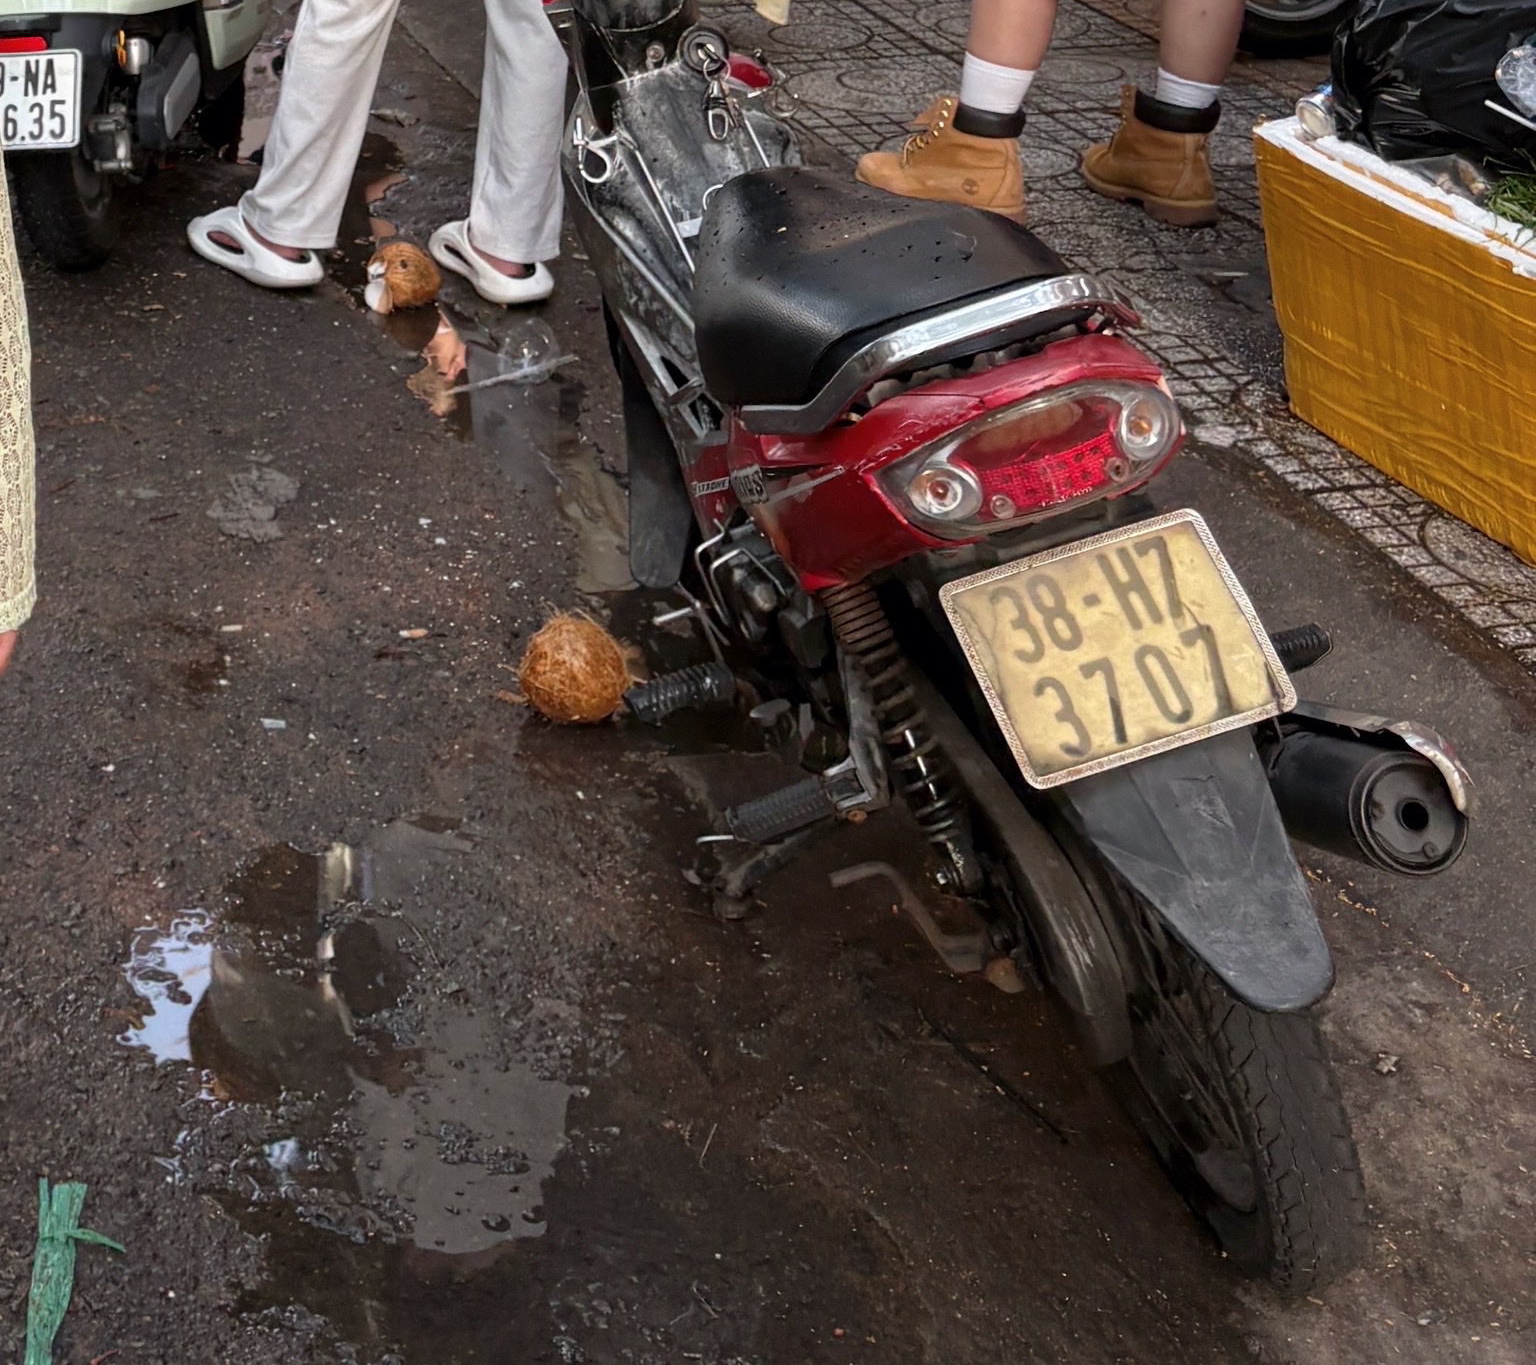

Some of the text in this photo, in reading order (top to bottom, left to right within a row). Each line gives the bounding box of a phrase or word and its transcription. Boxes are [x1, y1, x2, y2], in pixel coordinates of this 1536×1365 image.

[4, 99, 67, 142] 6.35
[989, 535, 1185, 664] 38-H7
[1032, 623, 1234, 758] 3707
